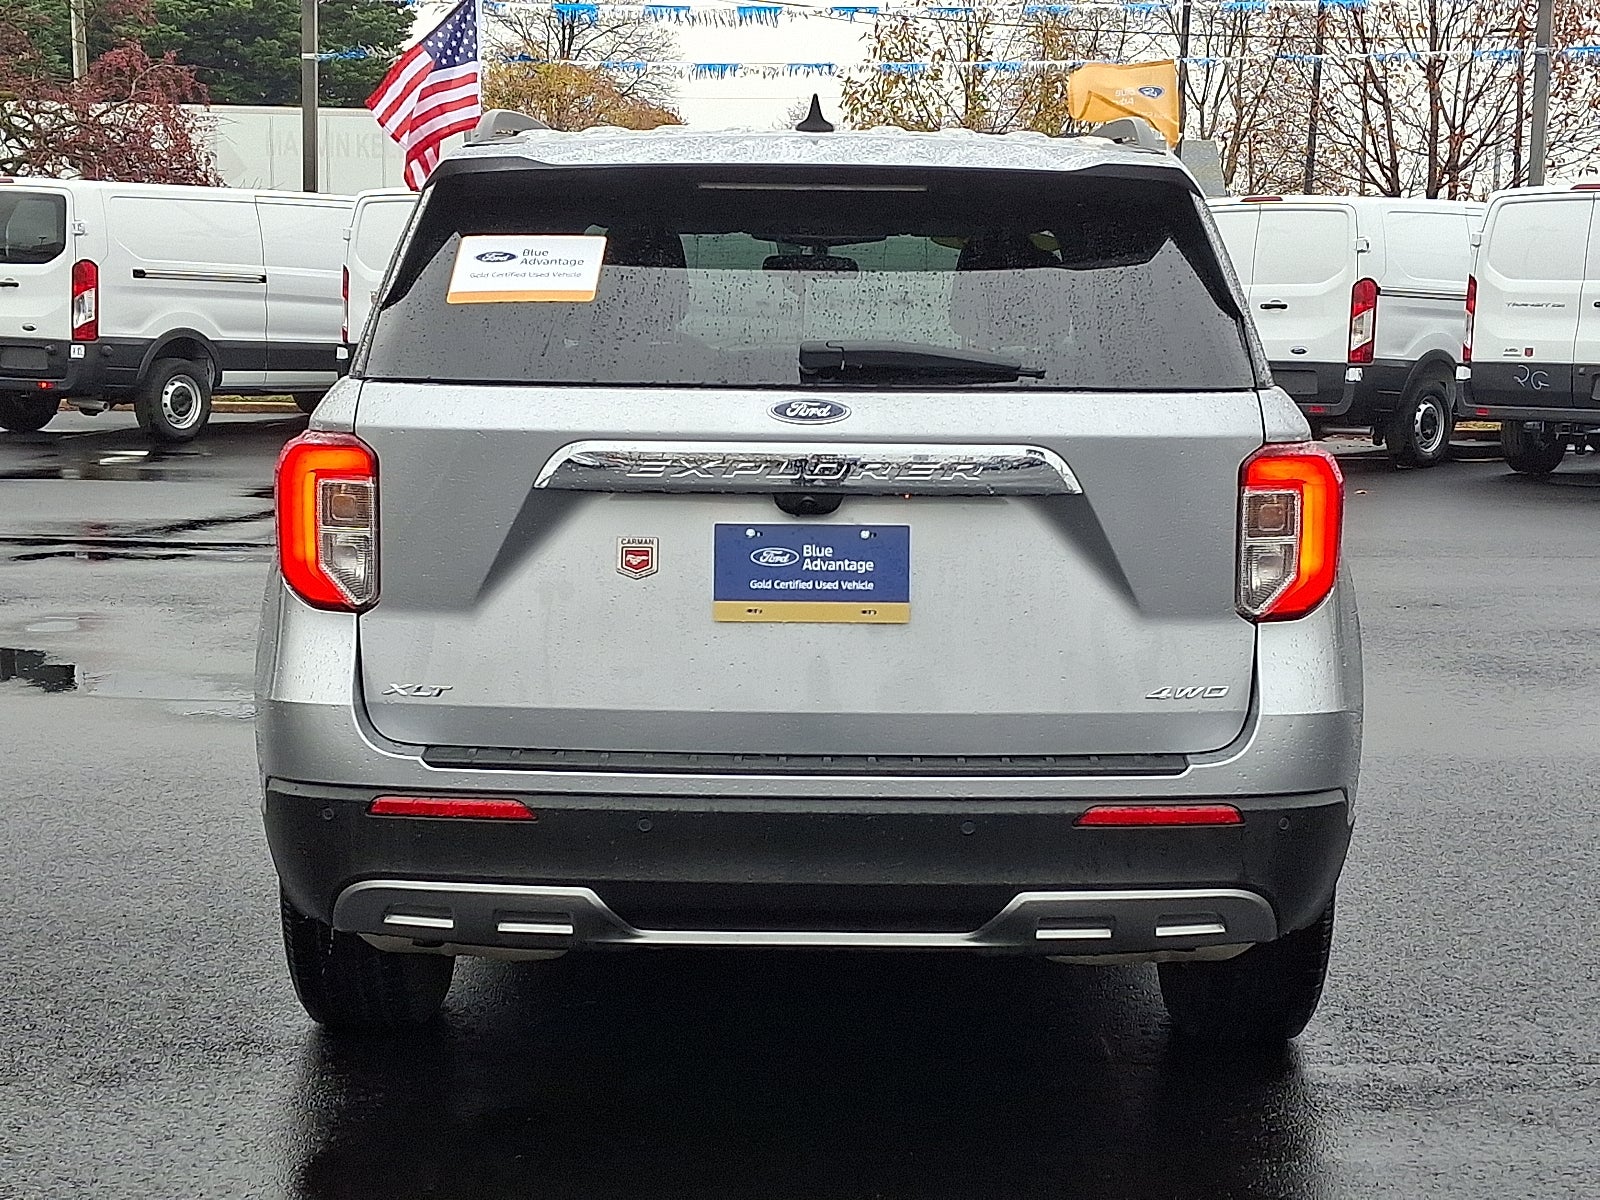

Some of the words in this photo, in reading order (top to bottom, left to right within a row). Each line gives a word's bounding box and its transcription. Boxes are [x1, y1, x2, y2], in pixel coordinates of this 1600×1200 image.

[522, 248, 549, 257] Blue
[520, 257, 585, 267] Advantage
[785, 401, 832, 417] Ford
[626, 459, 984, 481] EXPLORER
[759, 550, 790, 563] Ford
[802, 544, 833, 557] Blue
[802, 558, 874, 574] Advantage
[749, 579, 772, 589] Gold
[773, 579, 813, 589] Certified
[814, 580, 839, 590] Used
[840, 580, 874, 590] Vehicle
[382, 682, 454, 698] XLT
[1145, 685, 1230, 699] 4WD
